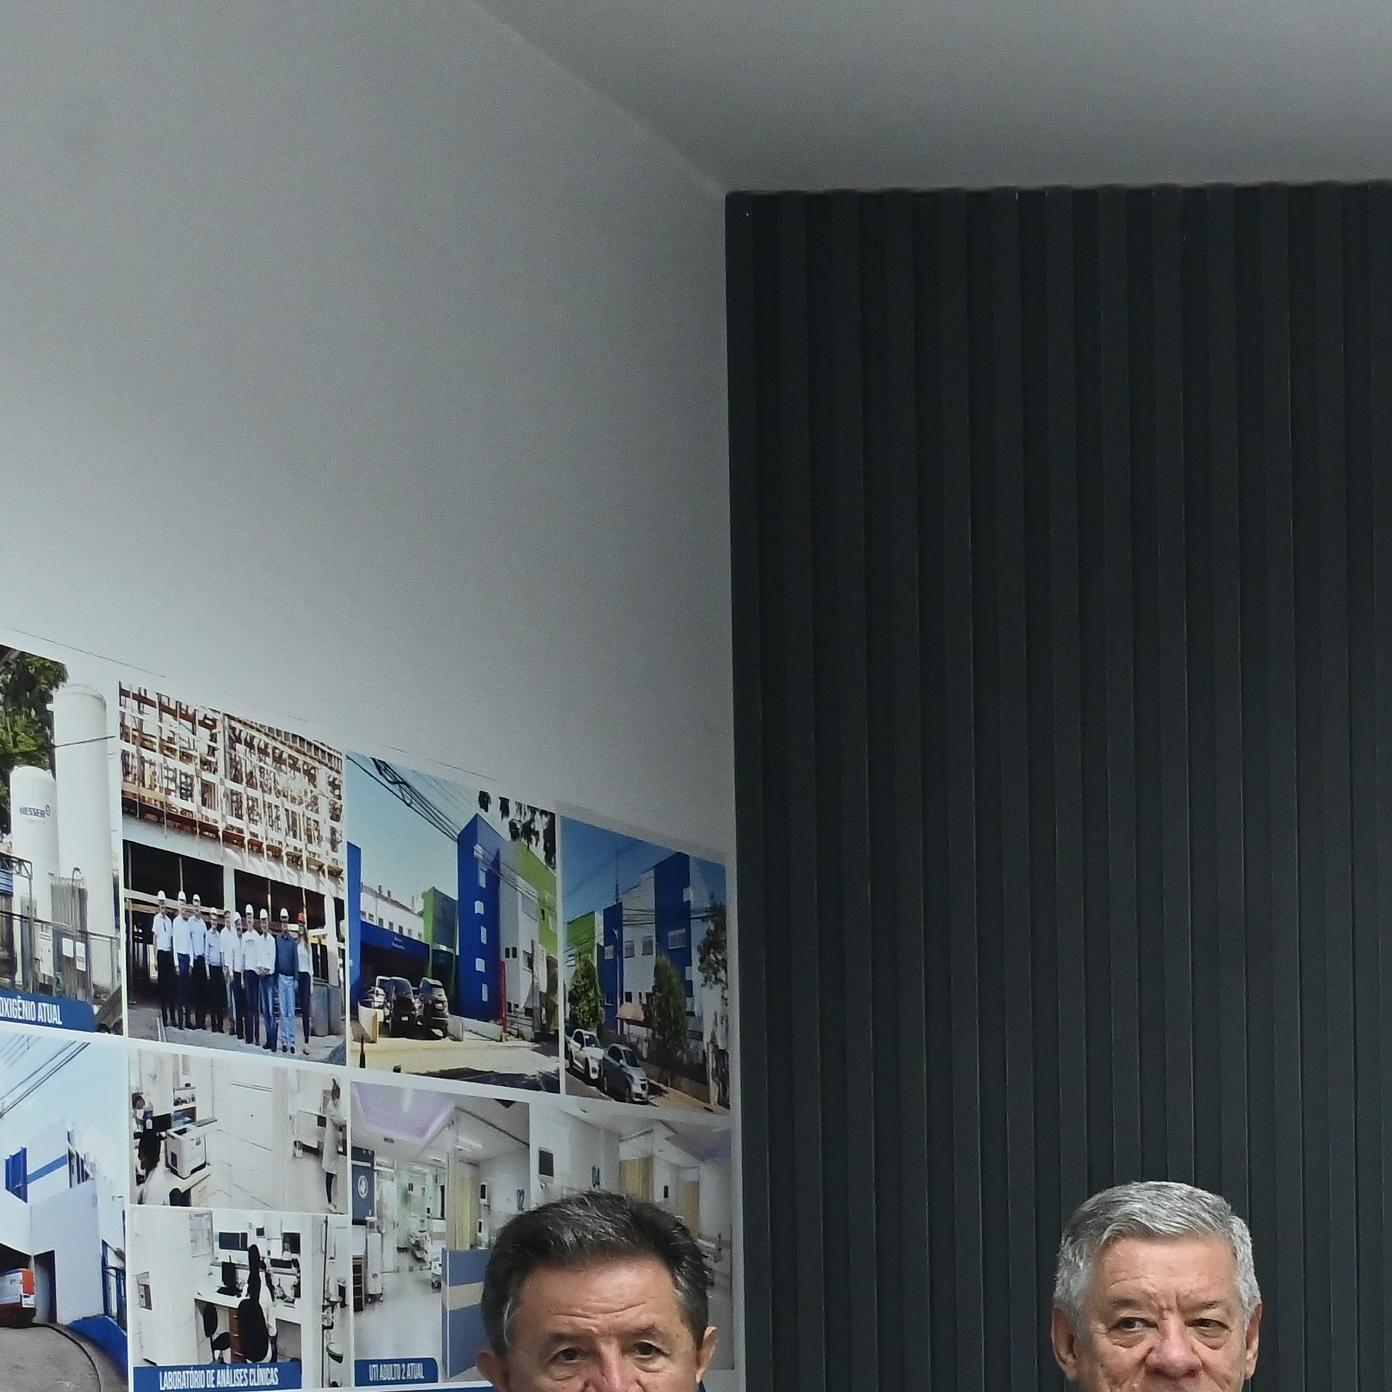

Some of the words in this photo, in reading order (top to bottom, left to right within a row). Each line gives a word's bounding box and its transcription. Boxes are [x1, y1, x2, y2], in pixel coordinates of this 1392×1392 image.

[38, 1001, 62, 1025] ATUAL
[159, 1367, 205, 1391] LABORATÓRIO
[206, 1369, 216, 1389] DE
[216, 1365, 248, 1388] ANÁLISES
[249, 1364, 279, 1386] CLÍNICAS
[407, 1362, 424, 1379] ATUAL
